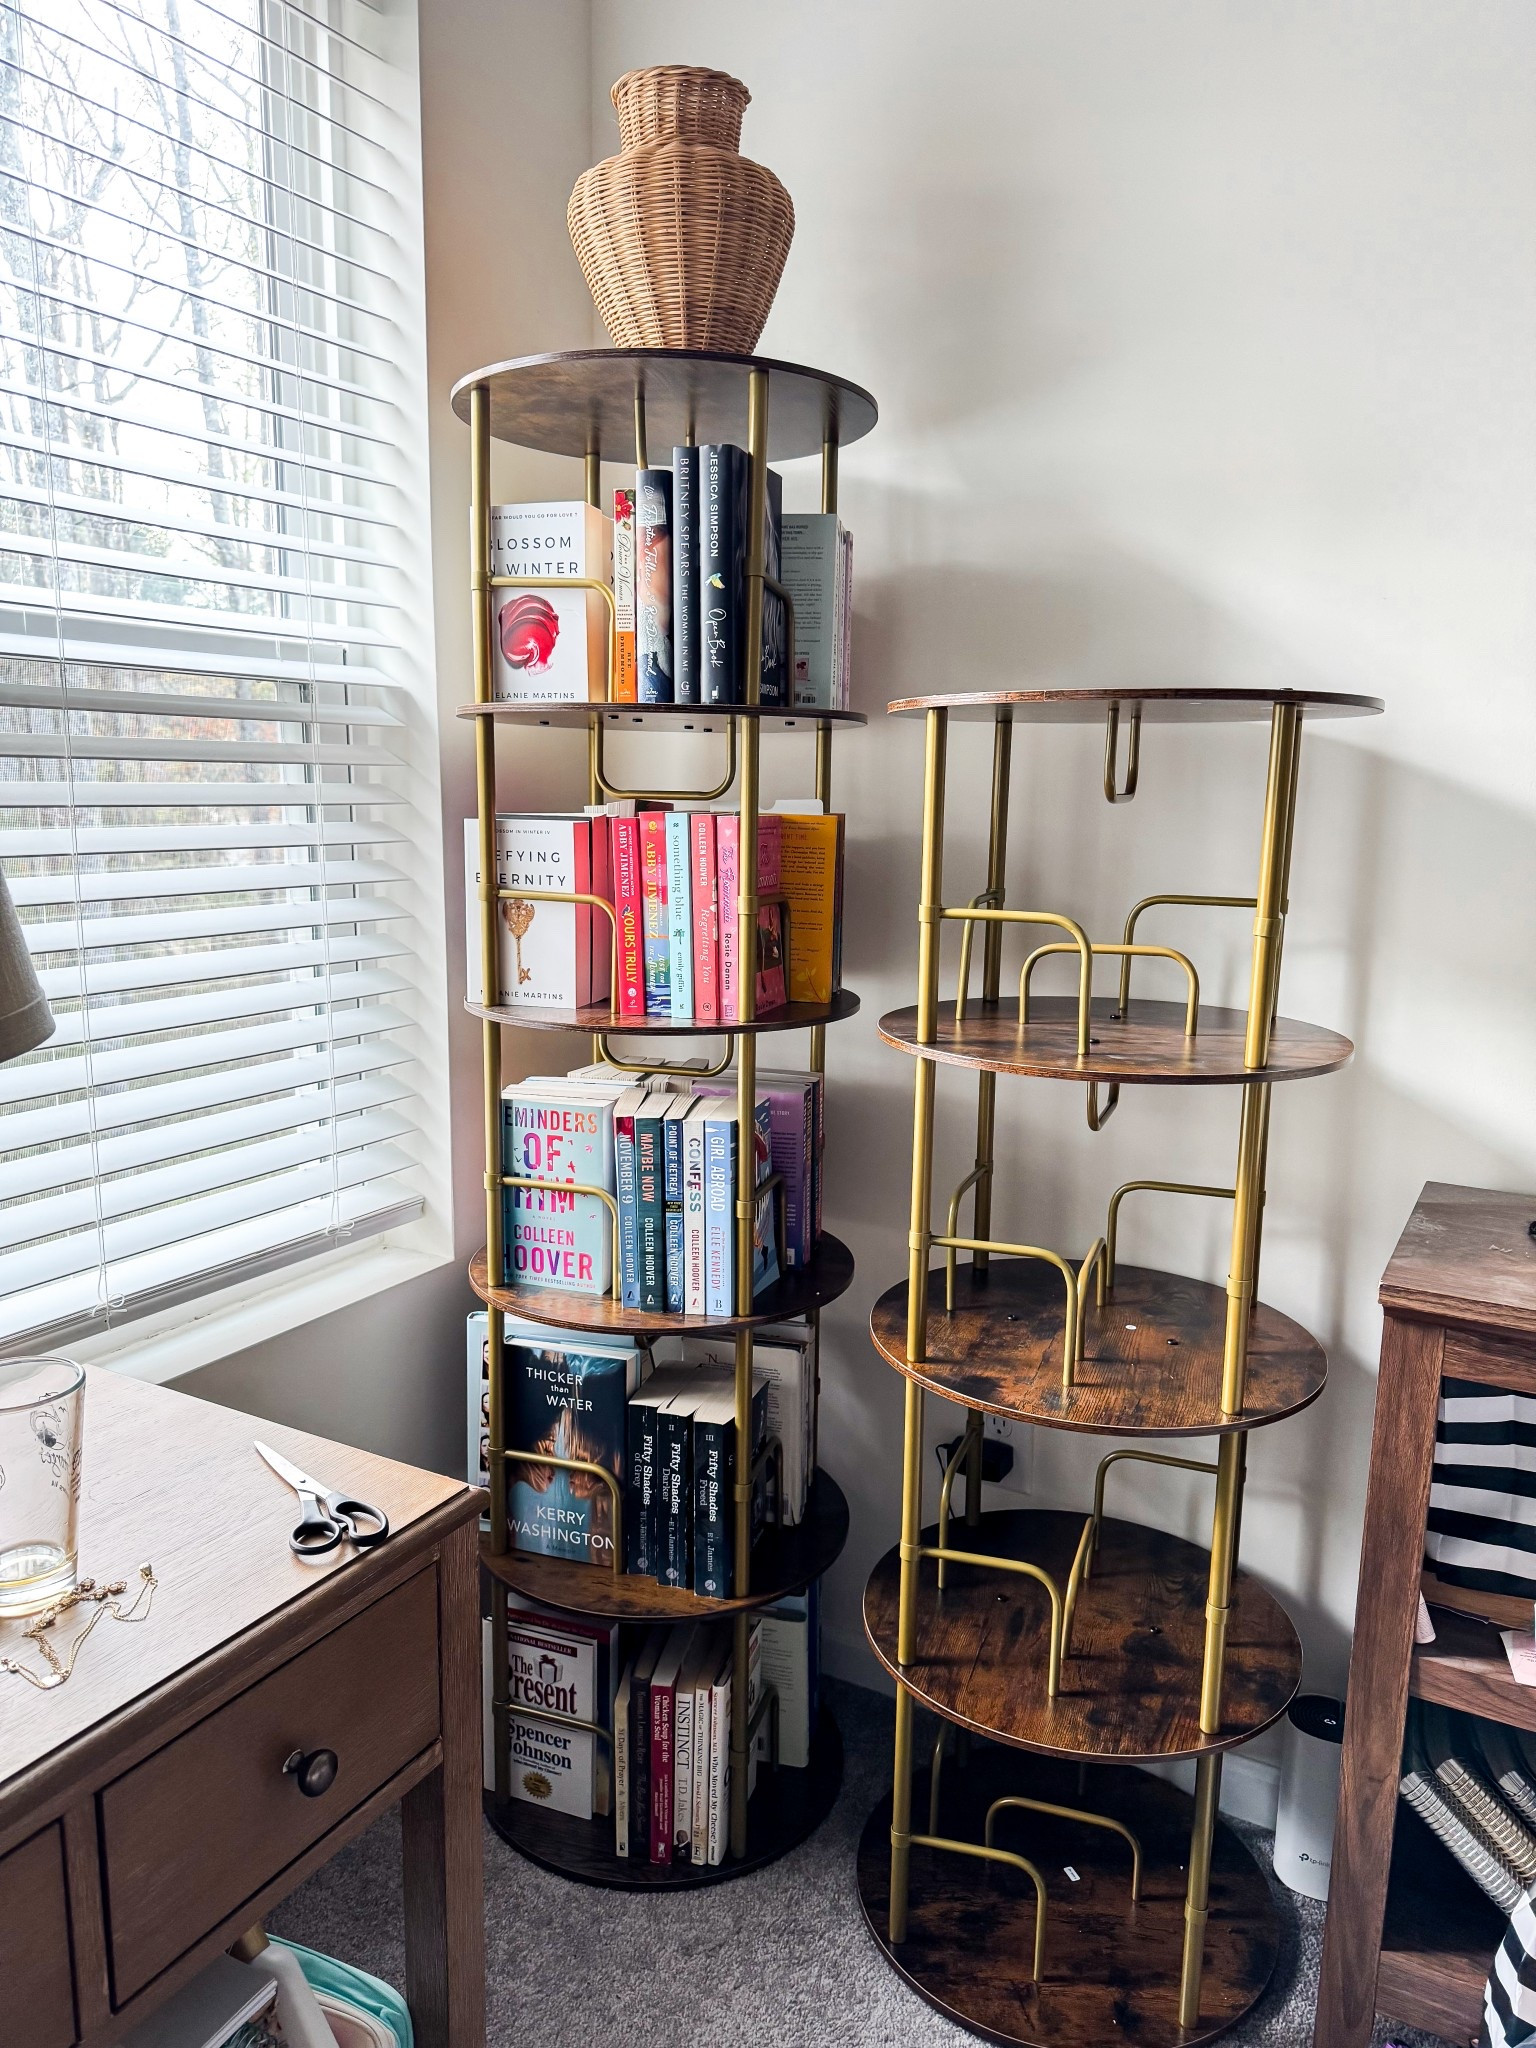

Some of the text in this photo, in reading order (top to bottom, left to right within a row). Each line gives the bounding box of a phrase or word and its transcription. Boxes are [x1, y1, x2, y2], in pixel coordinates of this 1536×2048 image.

[680, 458, 690, 578] BRITNEY SPEARS
[709, 451, 719, 558] JESSICA SIMPSON
[617, 534, 632, 565] Pioneer
[643, 504, 658, 586] Frontier Follies
[506, 562, 579, 576] WINTER
[618, 566, 633, 600] Woman
[644, 606, 658, 677] Ree Drummond
[682, 646, 688, 656] IN
[705, 607, 727, 668] Open Book
[682, 660, 688, 672] ME
[496, 850, 560, 862] EFYING
[618, 824, 630, 898] ABBY JIMENEZ
[698, 822, 708, 886] COLLEEN HOOVER
[476, 872, 566, 886] EERNITY
[646, 840, 658, 938] ABBY JIMENEZ
[672, 835, 684, 920] something blue
[720, 846, 736, 924] The Roommate
[624, 911, 637, 984] YOURS TRULY
[657, 954, 666, 972] JUST
[700, 908, 712, 984] Regretting You
[724, 933, 732, 990] Rosie Danan
[676, 952, 685, 992] emily giffin
[524, 992, 564, 1000] MARTINS
[504, 1106, 598, 1134] EMINDERS
[668, 1125, 678, 1148] POINT
[523, 1133, 564, 1172] OF
[619, 1134, 634, 1204] NOVEMBER 9
[640, 1133, 654, 1202] MAYBE NOW
[669, 1150, 678, 1161] OF
[669, 1163, 678, 1196] RETREAT
[689, 1138, 702, 1212] CONFESS
[710, 1136, 725, 1212] GIRL ABROAD
[514, 1224, 574, 1246] COLLEEN
[624, 1216, 634, 1283] COLLEEN HOOVER
[644, 1218, 655, 1286] COLLEEN HOOVER
[670, 1219, 679, 1252] COLLEEN
[670, 1256, 679, 1286] HOOVER
[691, 1229, 700, 1291] COLLEEN HOOVER
[711, 1226, 720, 1291] ELLE KENNEDY
[545, 1278, 576, 1286] BESTSELLING
[526, 1367, 582, 1386] THICKER
[551, 1384, 568, 1394] than
[546, 1394, 593, 1412] WATER
[633, 1452, 642, 1488] of Grey
[642, 1434, 653, 1504] Fifty Shades
[662, 1468, 670, 1502] Darker
[670, 1442, 680, 1514] Fifty Shades
[707, 1450, 718, 1522] Fifty Shades
[699, 1479, 708, 1505] Freed
[536, 1506, 586, 1526] KERRY
[506, 1518, 615, 1550] WASHINGTON
[510, 1634, 572, 1654] NATIONAL BESTSELLER
[512, 1654, 533, 1676] The
[654, 1695, 662, 1741] Woman's Soul
[662, 1695, 670, 1721] Chicken
[509, 1718, 571, 1750] Spencer
[661, 1722, 669, 1739] Soup
[677, 1700, 690, 1770] INSTINCT
[617, 1737, 625, 1787] Days of Prayer
[678, 1778, 688, 1822] T.D. Jakes
[711, 1800, 718, 1811] My
[710, 1813, 718, 1843] Cheese?
